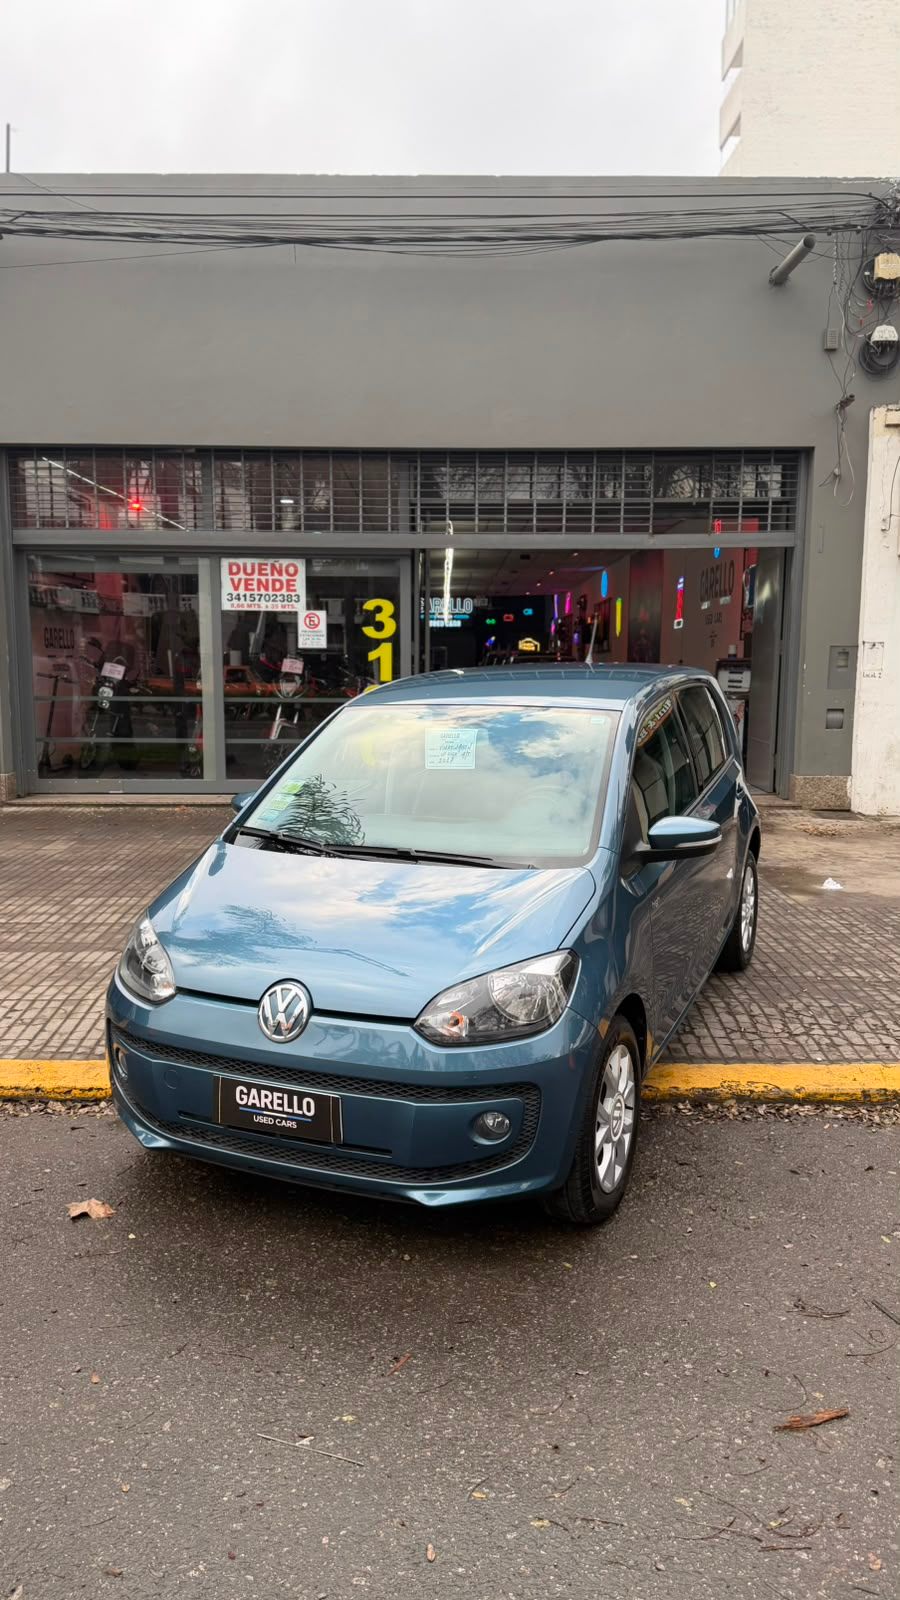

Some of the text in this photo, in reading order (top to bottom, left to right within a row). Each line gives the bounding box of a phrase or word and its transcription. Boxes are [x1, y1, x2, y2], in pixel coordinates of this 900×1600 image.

[228, 560, 299, 577] DUEÑO
[230, 578, 297, 592] VENDE
[226, 593, 300, 603] 3415702383
[44, 626, 75, 649] GARELLO
[235, 1085, 316, 1117] GARELLO
[253, 1114, 298, 1129] USED CARS
